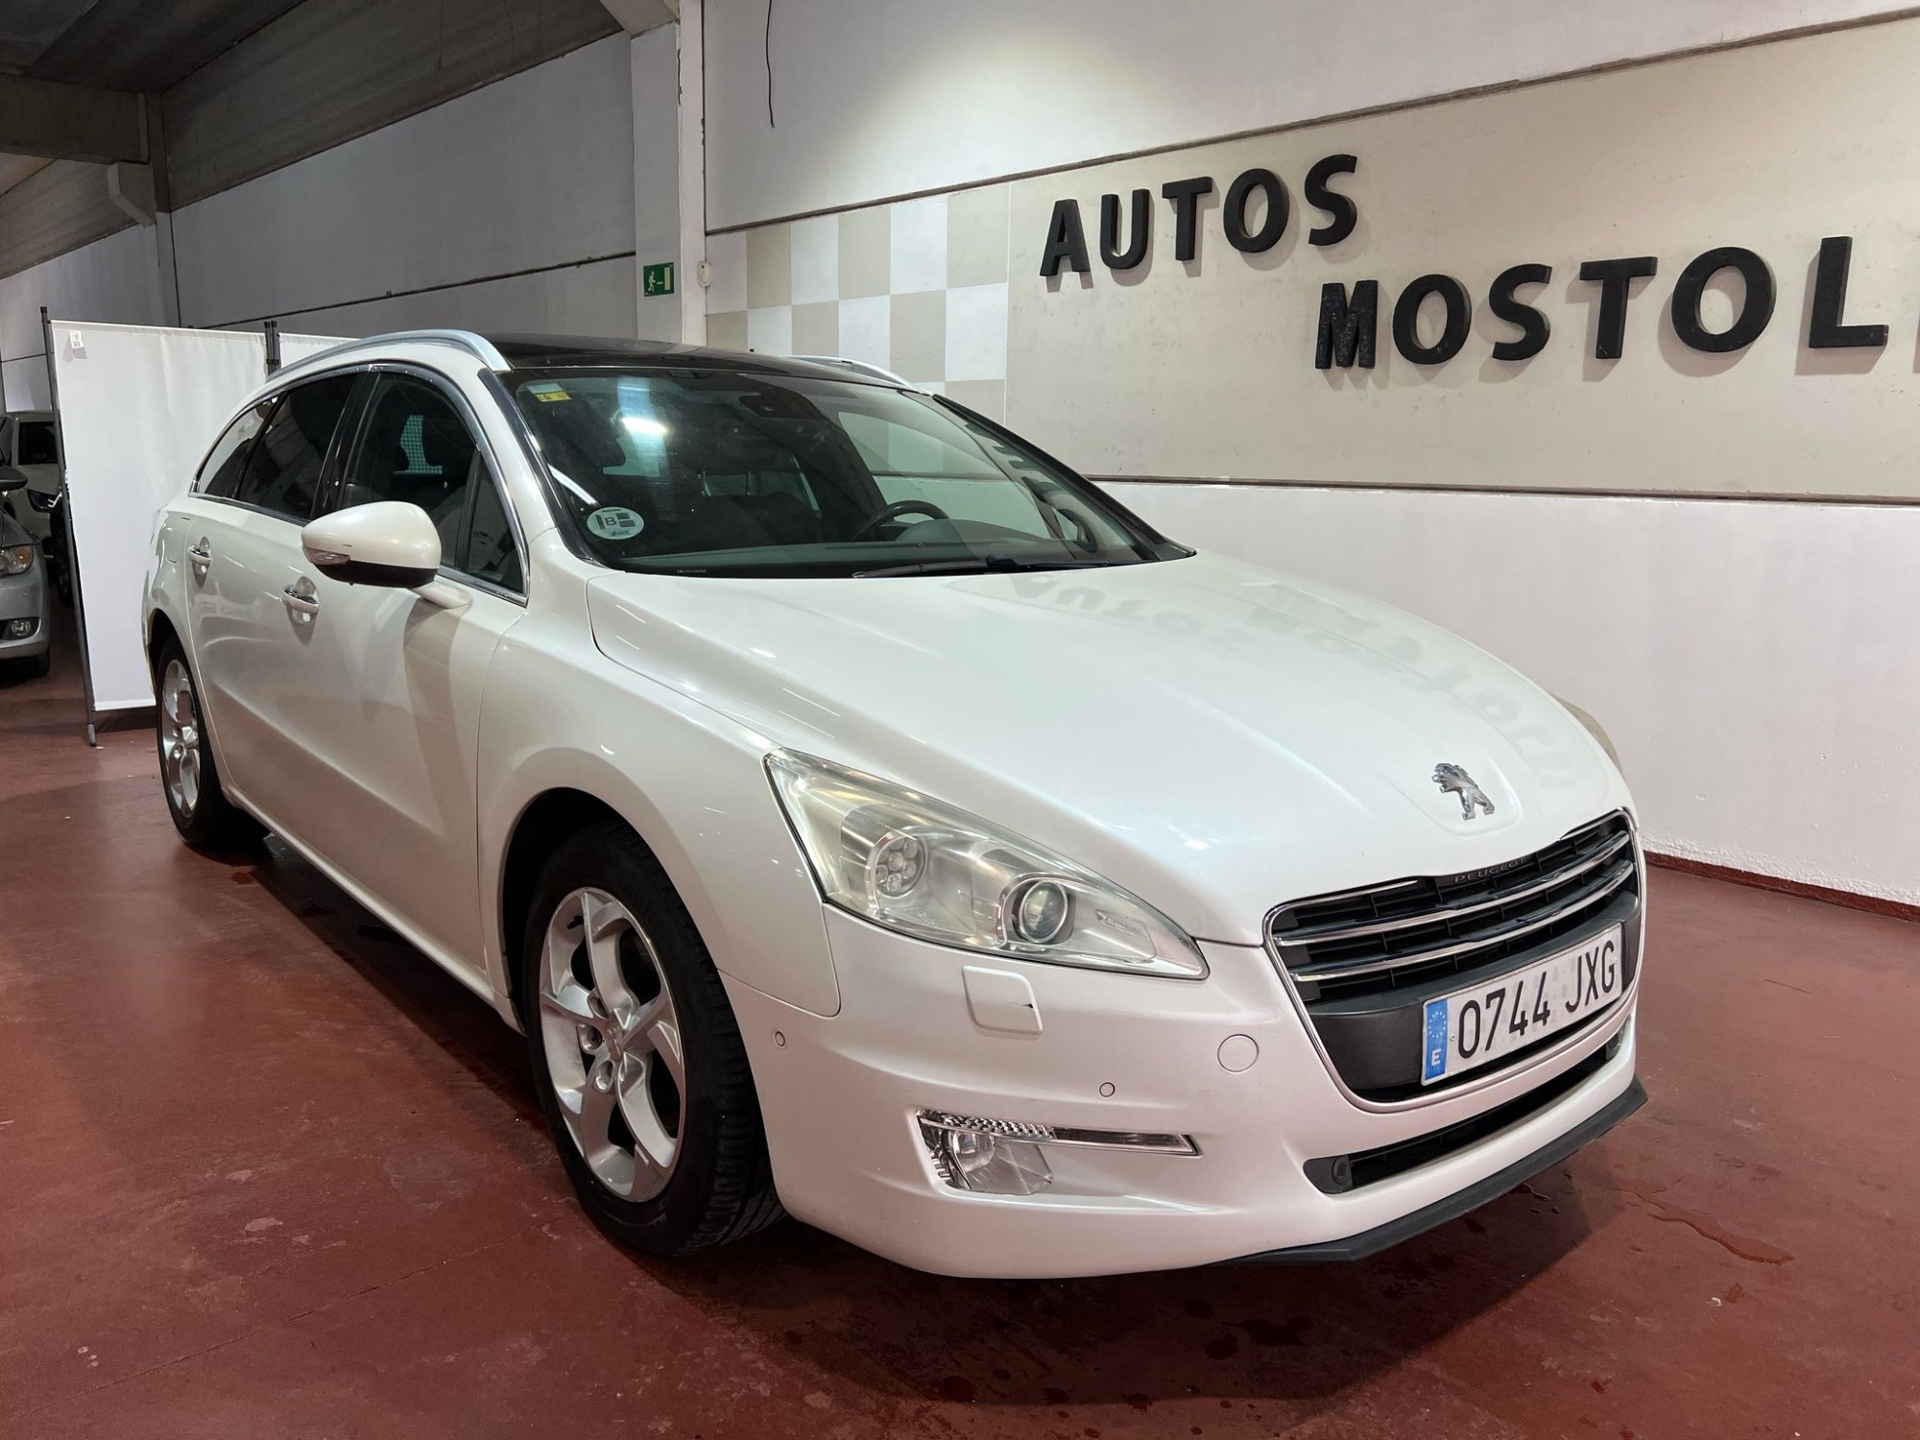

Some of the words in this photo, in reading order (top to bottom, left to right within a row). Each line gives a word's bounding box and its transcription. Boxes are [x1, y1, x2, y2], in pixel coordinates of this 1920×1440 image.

[1039, 154, 1358, 277] AUTOS
[1454, 858, 1526, 883] PEUGEOT
[1458, 970, 1550, 1059] 0744
[1565, 940, 1616, 1013] JXG
[1431, 1048, 1442, 1066] E
